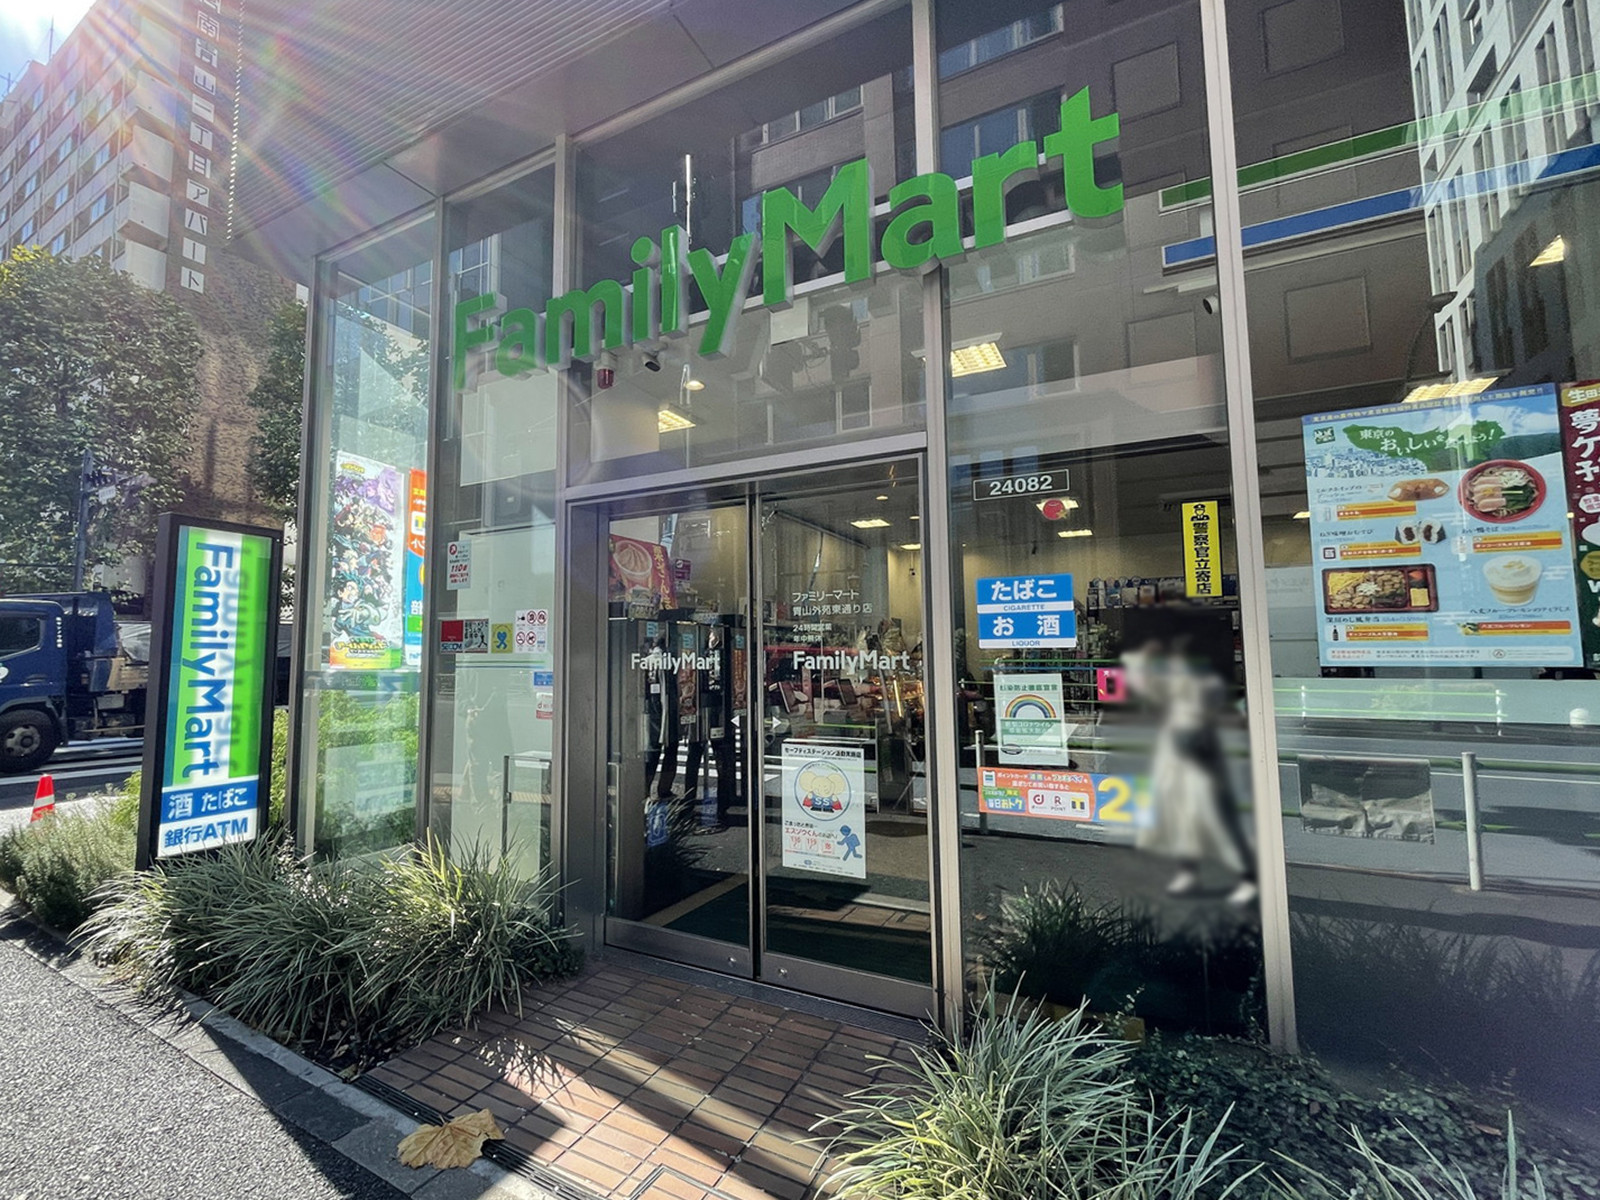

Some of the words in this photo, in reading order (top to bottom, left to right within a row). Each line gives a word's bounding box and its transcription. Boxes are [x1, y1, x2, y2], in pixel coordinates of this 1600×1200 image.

[452, 84, 1125, 392] FamilyMart
[1568, 388, 1600, 403] 生田
[1359, 428, 1395, 441] 東京の
[989, 475, 1053, 496] 24082
[1192, 521, 1212, 595] 警察官立寄店
[792, 589, 860, 602] ファミリーマート
[991, 579, 1058, 601] たばこ
[1011, 639, 1041, 647] LIQUOR
[181, 541, 235, 779] FamilyMart
[630, 652, 721, 674] FamilyMart
[792, 649, 911, 676] FamilyMart
[167, 792, 194, 820] 酒
[201, 787, 248, 813] たばこ
[814, 797, 830, 807] SS
[164, 816, 249, 848] 銀行ATM
